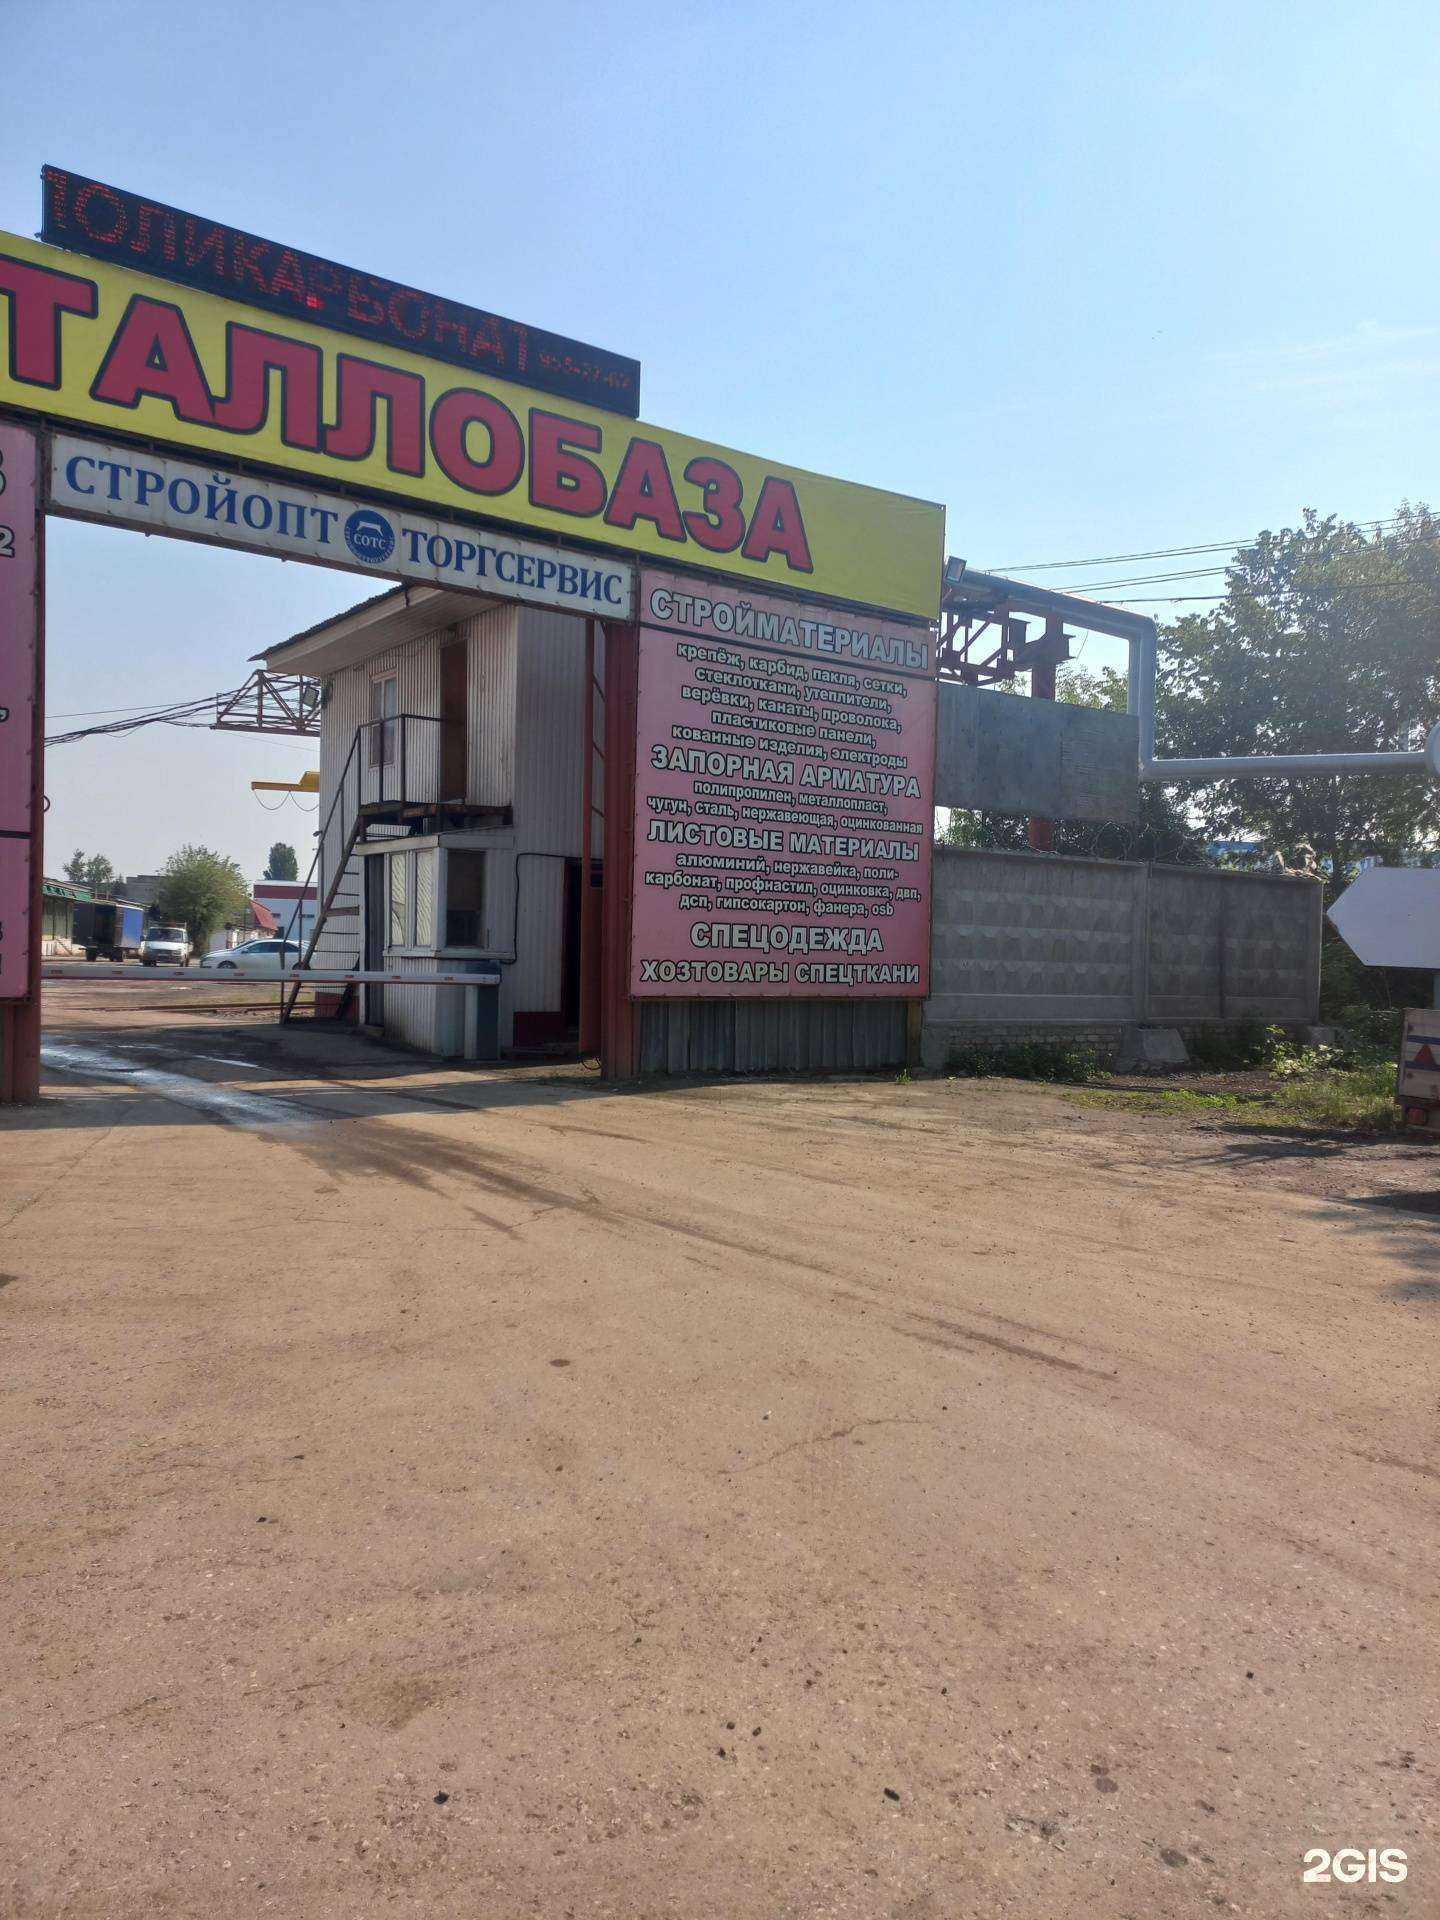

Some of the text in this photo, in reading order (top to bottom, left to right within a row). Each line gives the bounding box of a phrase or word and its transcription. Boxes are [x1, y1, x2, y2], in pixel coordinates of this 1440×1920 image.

[65, 454, 339, 545] СТРОЙОПТ
[401, 526, 623, 606] ТОРГСЕРВИС
[650, 588, 929, 670] СТРОЙМАТЕРИАЛЫ
[677, 642, 907, 697] крепёж, карбид, пакля, сетки,
[682, 685, 902, 733] верёвки, канаты, проволока,
[695, 668, 892, 714] стеклоткани, утеплители,
[672, 725, 907, 769] кованные изделия, электроды
[711, 711, 877, 748] пластиковые панели,
[650, 744, 921, 799] ЗАПОРНАЯ АРМАТУРА
[647, 796, 923, 835] чугун, сталь, нержавеющая, оцинкованная
[694, 780, 888, 815] полипропилен, металлопласт,
[647, 819, 920, 861] ЛИСТОВЫЕ МАТЕРИАЛЫ
[644, 871, 921, 902] карбонат, профнастил, оцинковка, двп,
[676, 852, 899, 880] алюминий, нержавейка, поли-
[679, 894, 713, 911] дсп,
[716, 897, 811, 916] гипсокартон,
[813, 901, 869, 918] фанера,
[690, 922, 884, 955] СПЕЦОДЕЖДА
[640, 960, 920, 987] ХОЗТОВАРЫ СПЕЦТКАНИ
